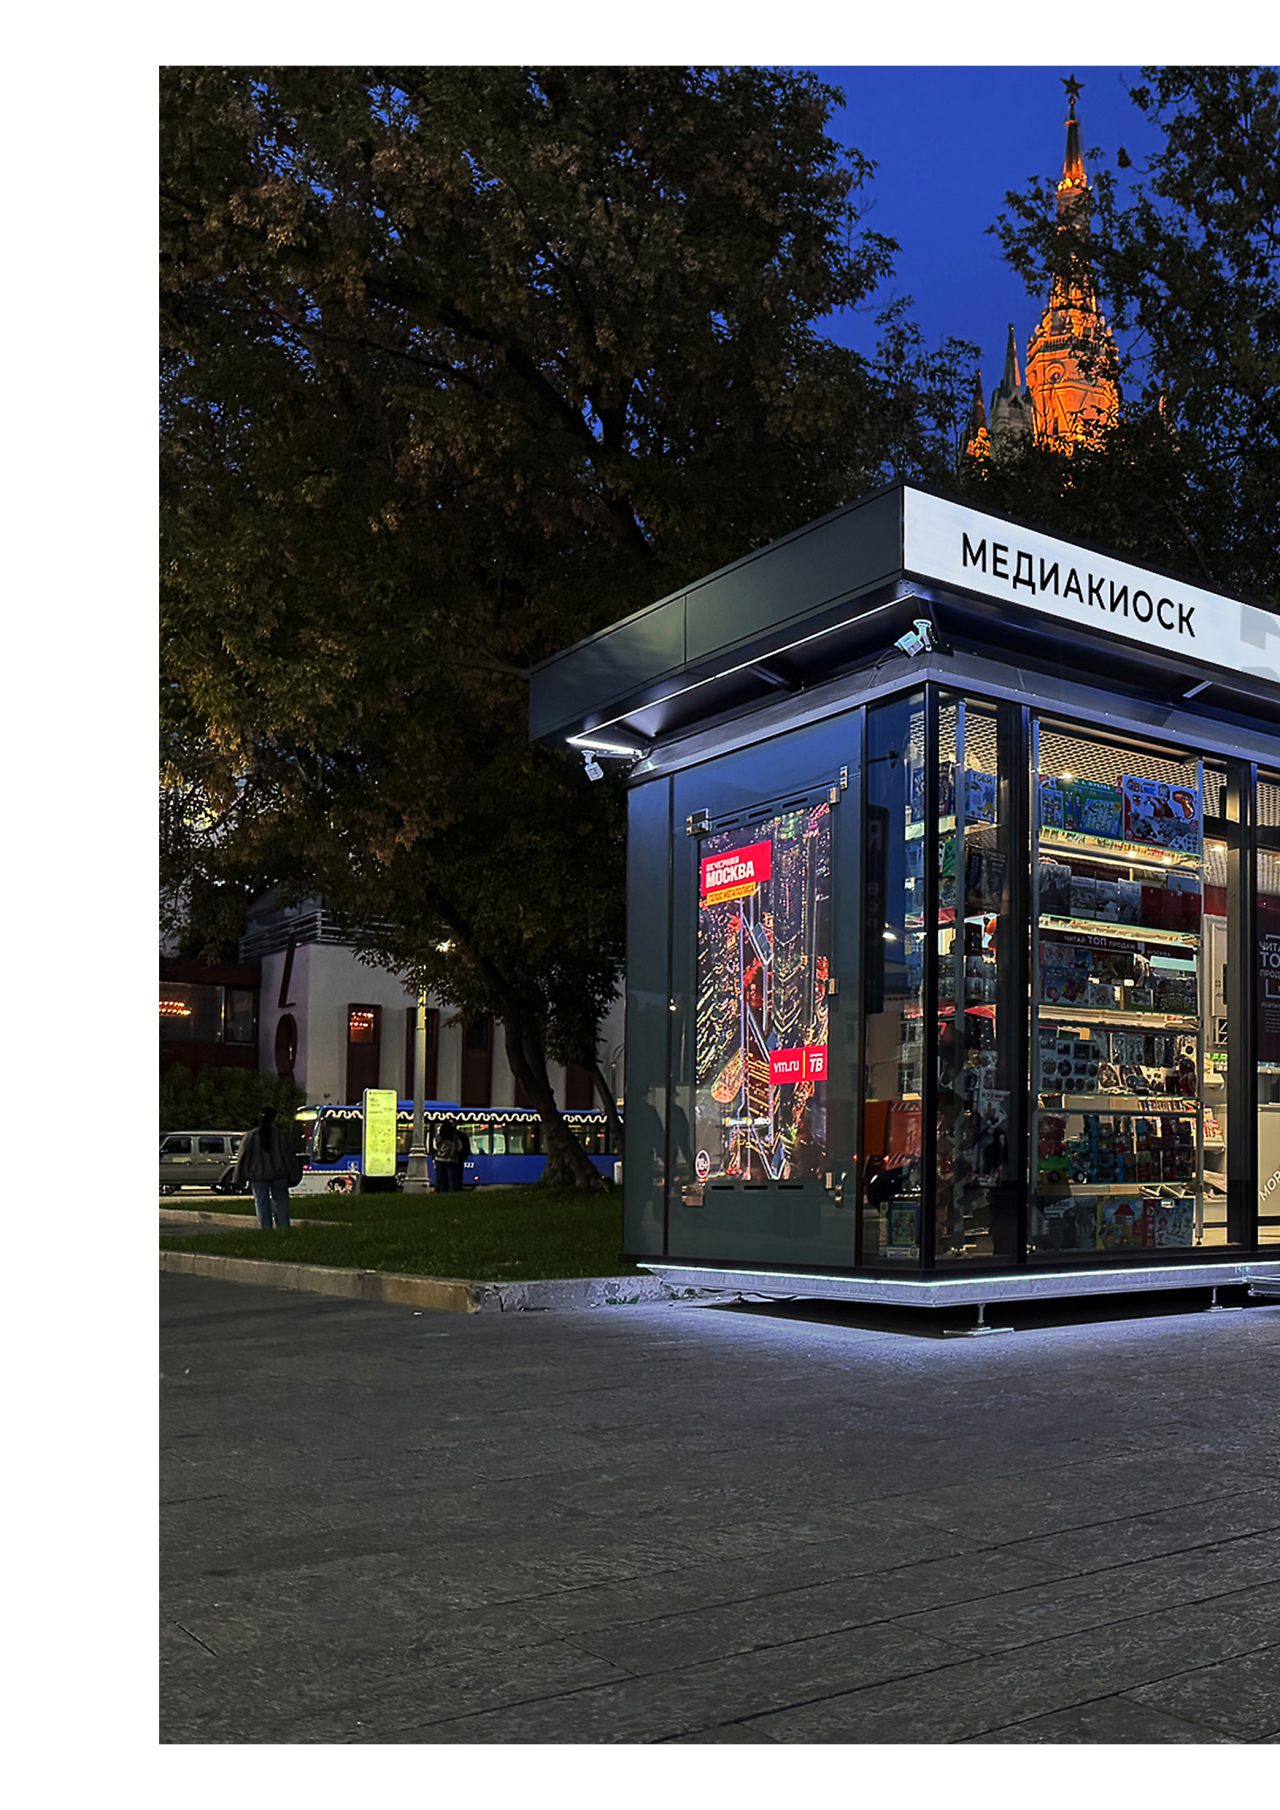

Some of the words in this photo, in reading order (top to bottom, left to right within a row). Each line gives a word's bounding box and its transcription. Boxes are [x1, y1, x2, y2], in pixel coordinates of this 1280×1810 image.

[962, 532, 1196, 638] МЕДИАКИОСК
[706, 861, 755, 889] МОСКВА
[1087, 935, 1107, 947] ТОП
[1108, 940, 1136, 951] ПРОДАЖ
[773, 1060, 800, 1073] vm.ru
[809, 1057, 824, 1073] ТВ
